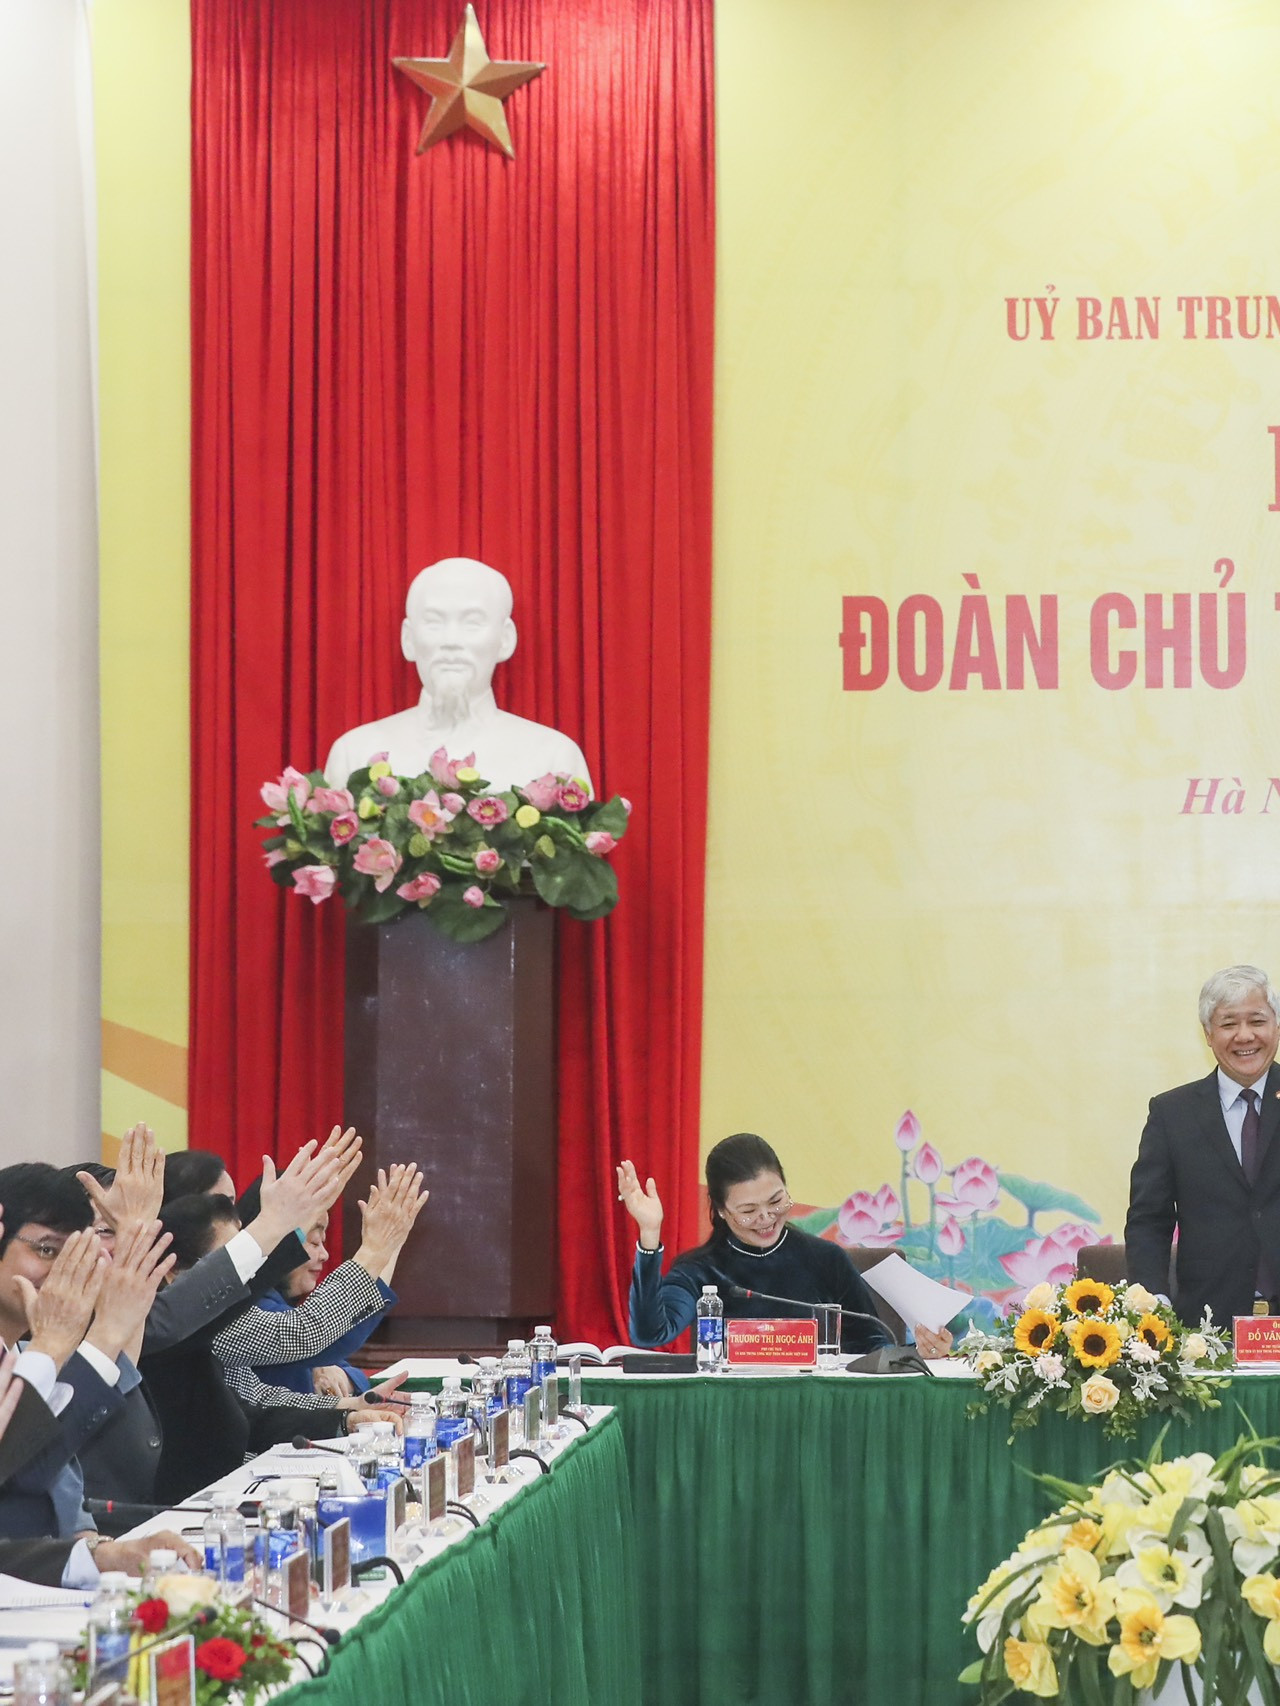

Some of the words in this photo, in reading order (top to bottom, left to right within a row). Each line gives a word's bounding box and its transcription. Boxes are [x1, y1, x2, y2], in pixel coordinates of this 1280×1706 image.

[1005, 284, 1059, 341] UỶ
[1076, 296, 1160, 341] BAN
[839, 573, 1059, 692] ĐOÀN
[1090, 558, 1247, 690] CHỦ
[1178, 777, 1246, 815] Hà
[775, 1334, 796, 1346] NGỌC
